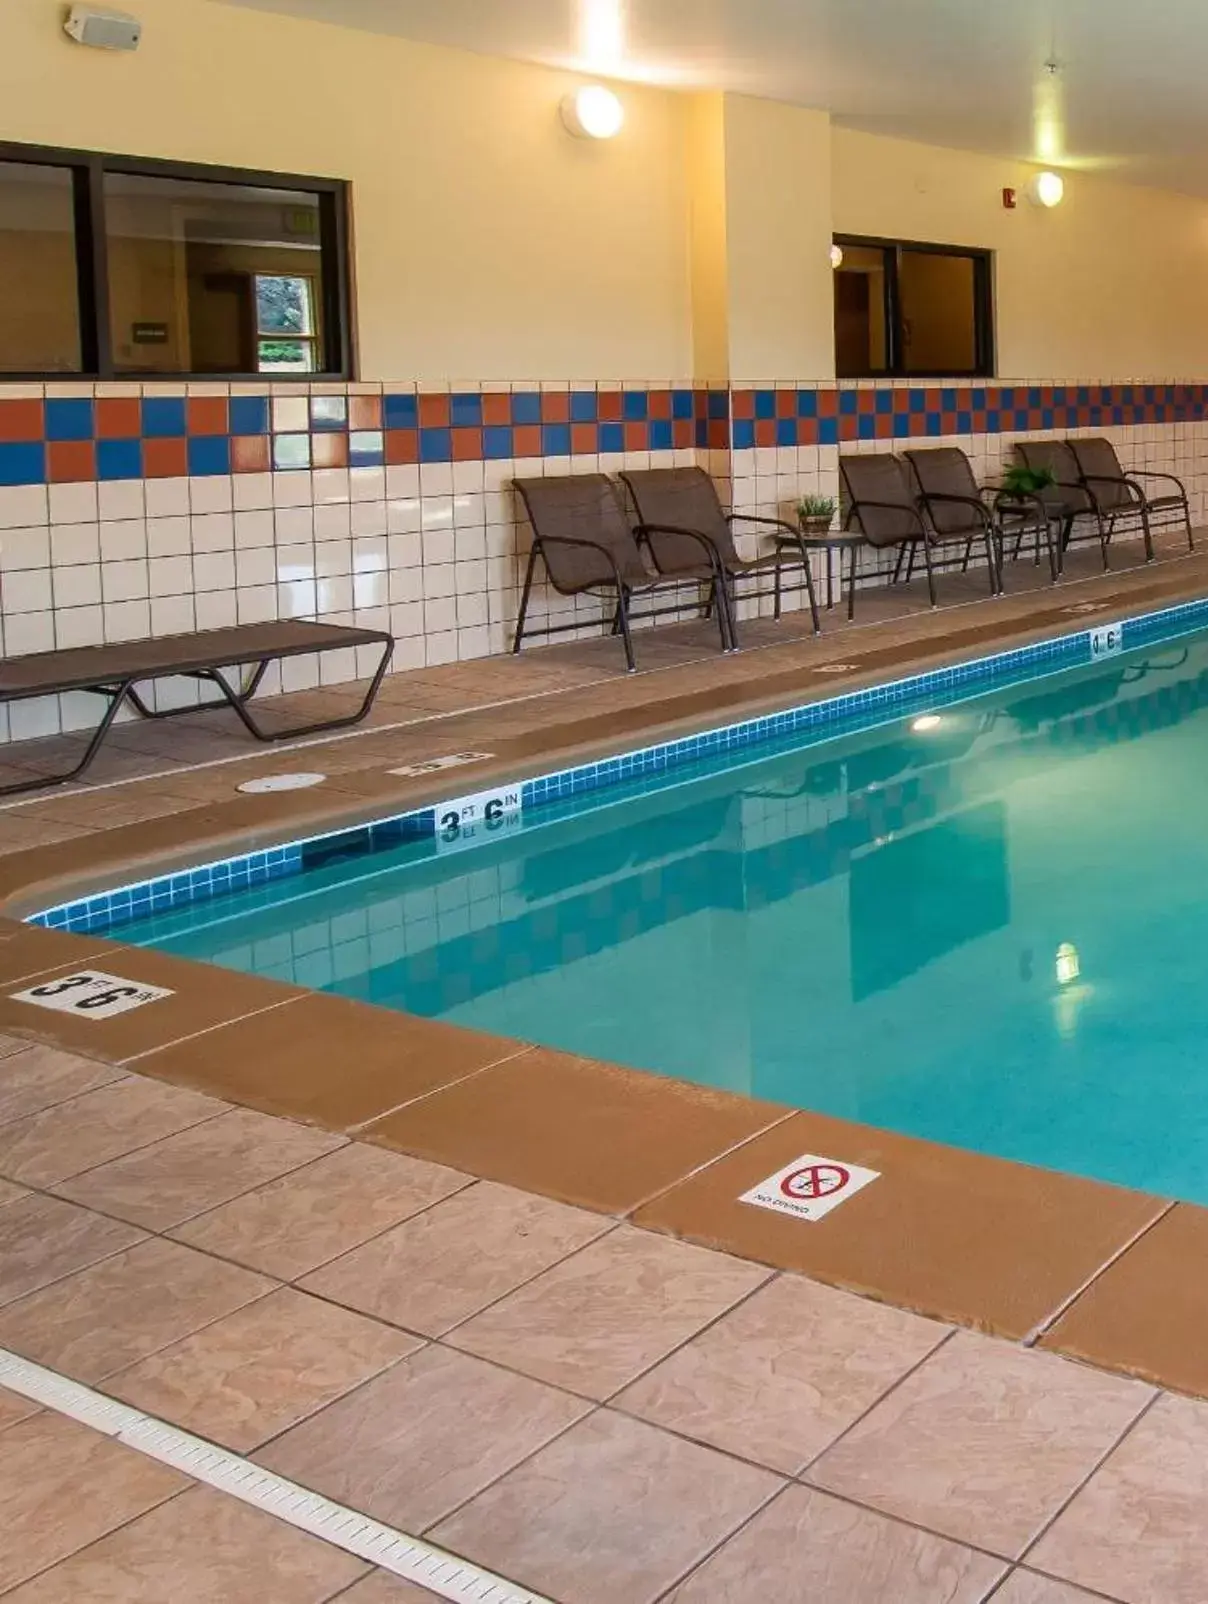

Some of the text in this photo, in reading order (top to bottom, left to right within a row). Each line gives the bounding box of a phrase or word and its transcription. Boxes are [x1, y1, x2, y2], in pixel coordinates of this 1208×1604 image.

[440, 793, 518, 842] 3 FT 6 IN
[30, 976, 93, 997] 3
[75, 987, 138, 1009] 6
[754, 1194, 809, 1214] NO DIVING
